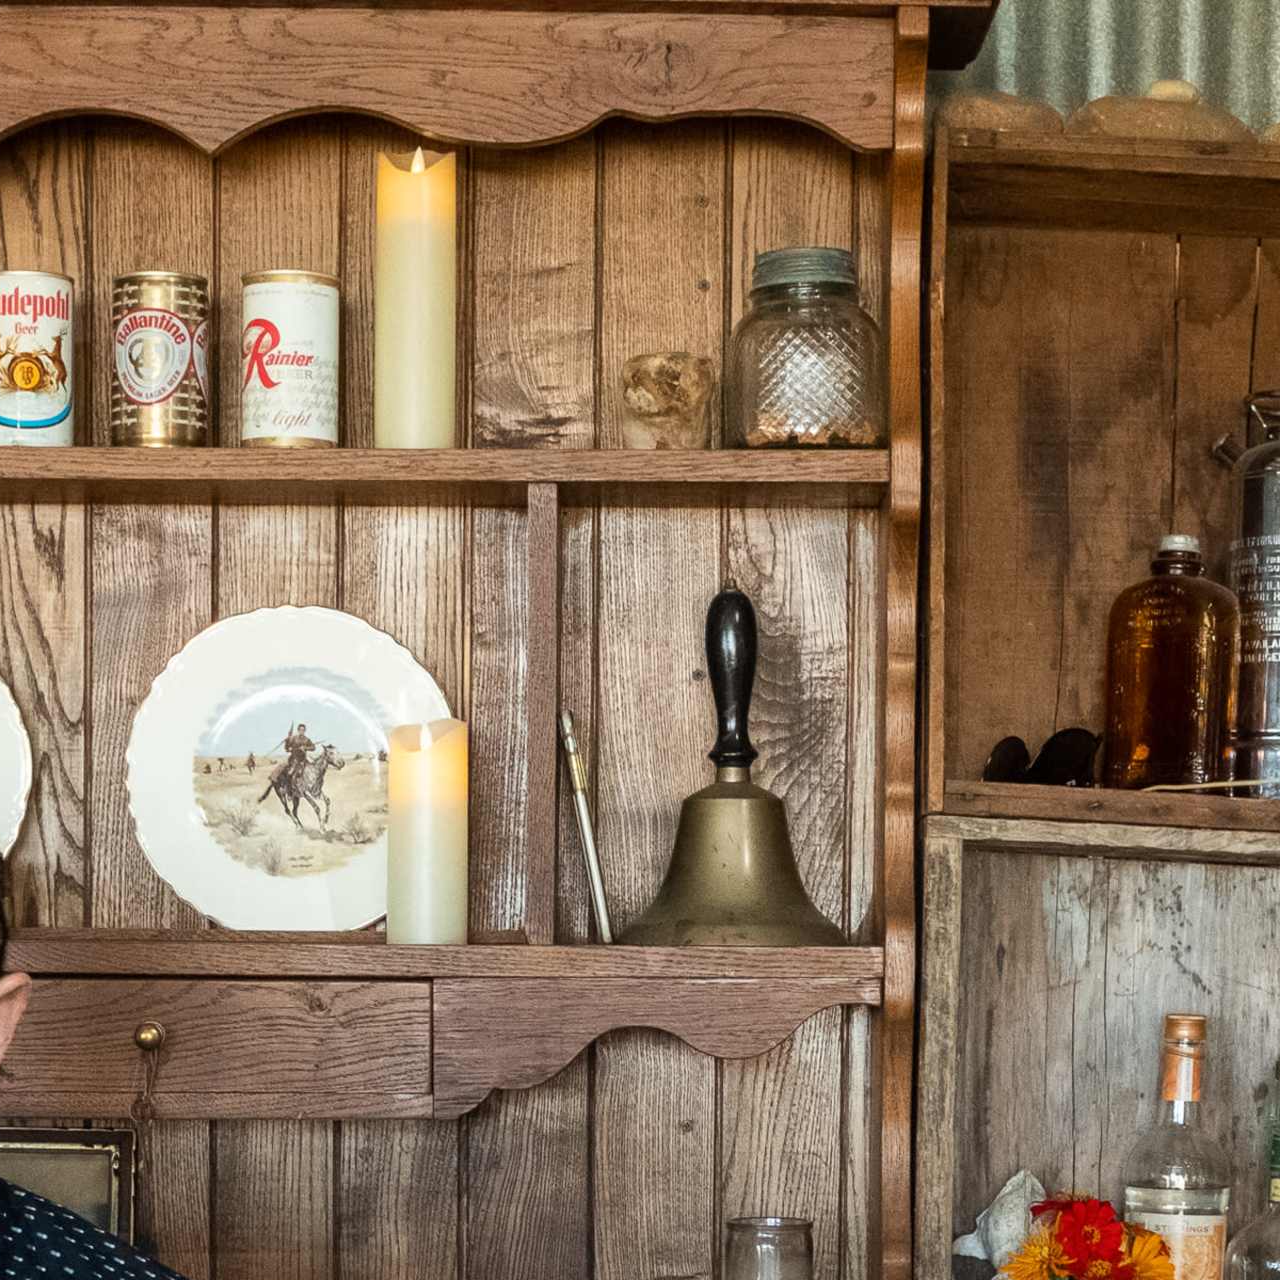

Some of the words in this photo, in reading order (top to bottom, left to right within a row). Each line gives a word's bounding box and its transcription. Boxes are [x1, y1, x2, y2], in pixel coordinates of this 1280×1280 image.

[14, 322, 39, 335] Beer
[116, 314, 187, 346] Ballantine
[242, 318, 314, 393] Rainier
[167, 370, 181, 388] BEER
[145, 386, 167, 400] LAGER
[1154, 1224, 1210, 1234] STINGS
